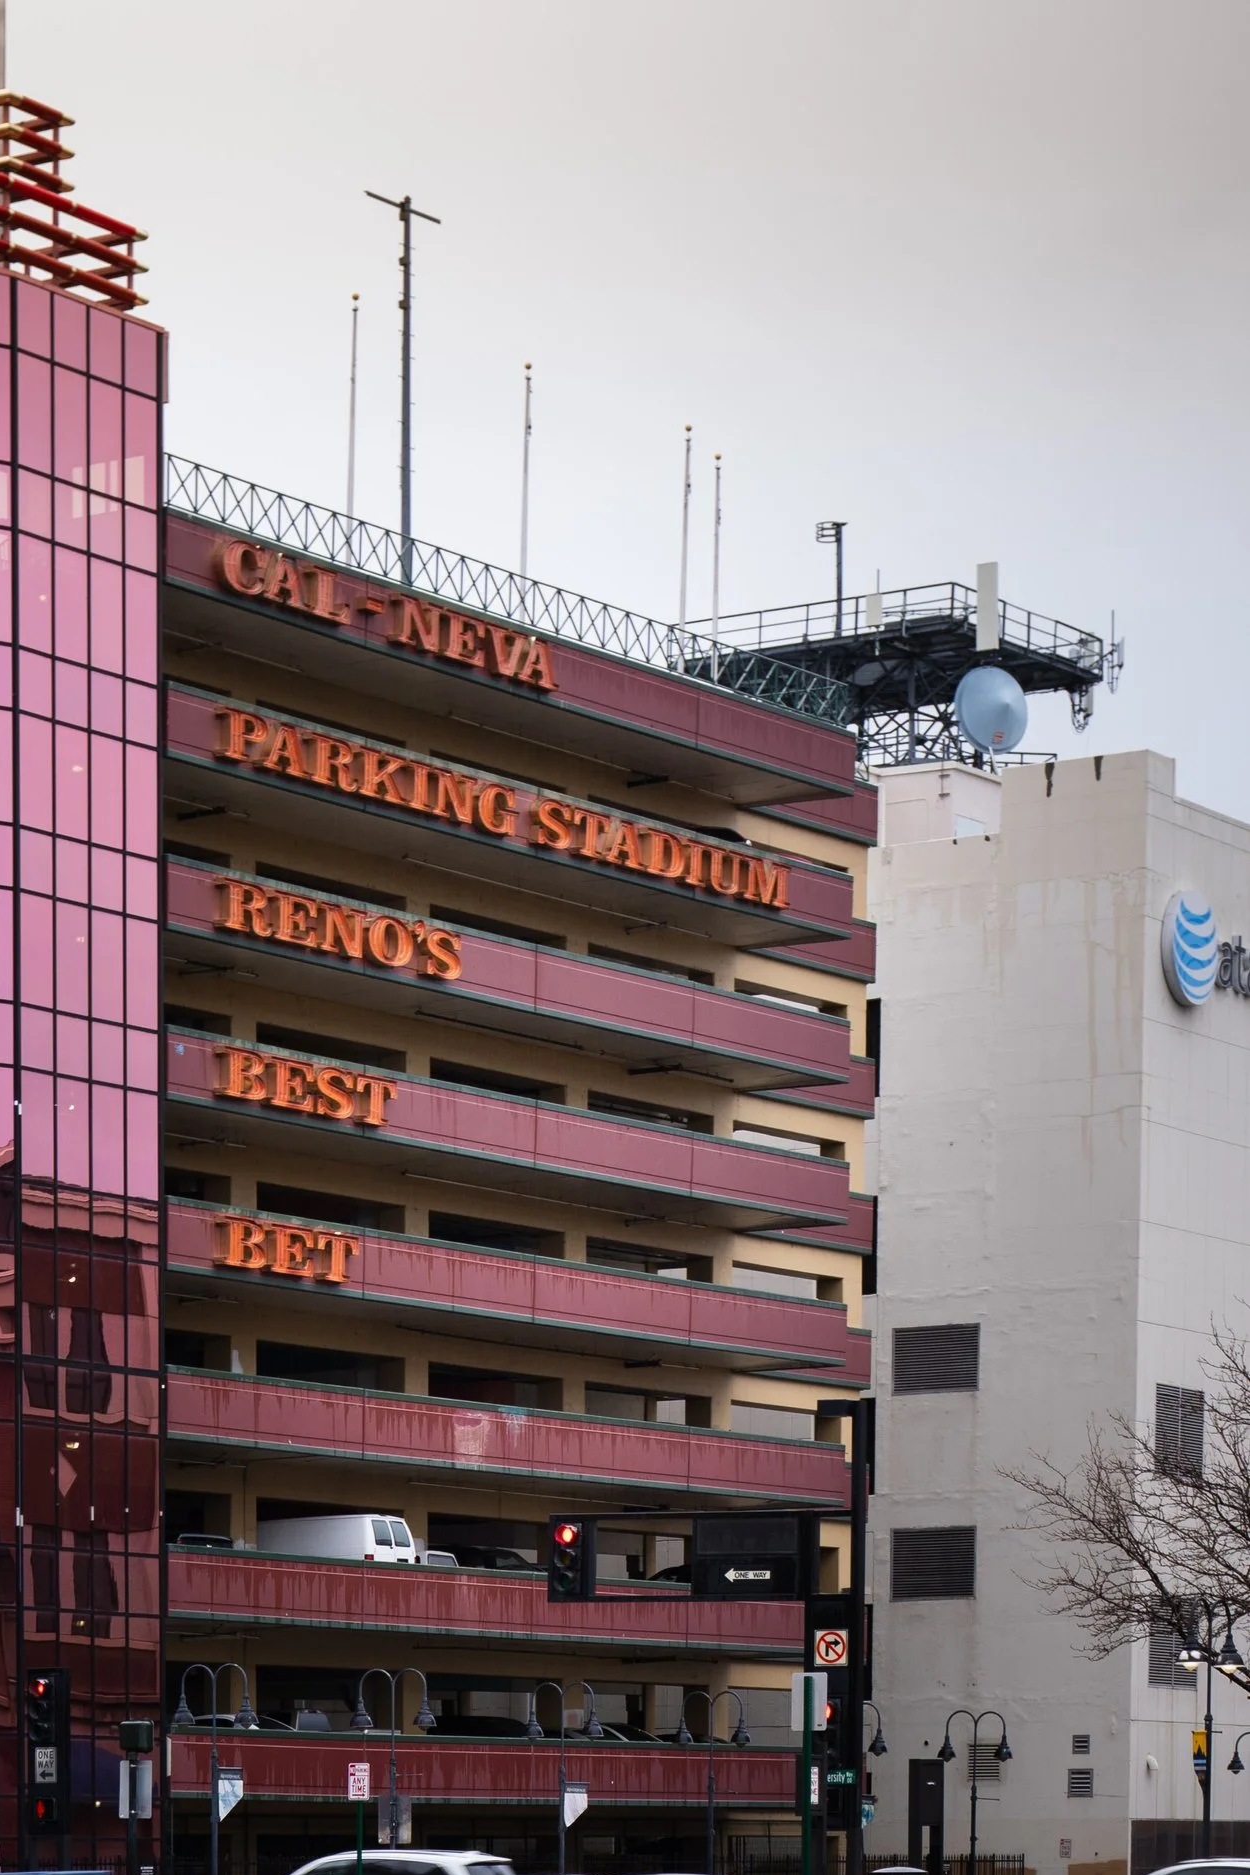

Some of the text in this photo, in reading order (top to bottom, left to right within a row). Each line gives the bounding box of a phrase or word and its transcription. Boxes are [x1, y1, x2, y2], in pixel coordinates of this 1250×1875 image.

[214, 705, 792, 910] PARKING STADIUM
[214, 874, 463, 982] RENO'S
[1215, 934, 1250, 996] at
[214, 1043, 398, 1128] BEST
[214, 1211, 360, 1284] BET
[734, 1571, 750, 1579] ONE
[38, 1750, 55, 1760] ONE
[38, 1760, 55, 1769] WAY
[352, 1777, 366, 1785] ANY
[352, 1784, 367, 1794] TIME
